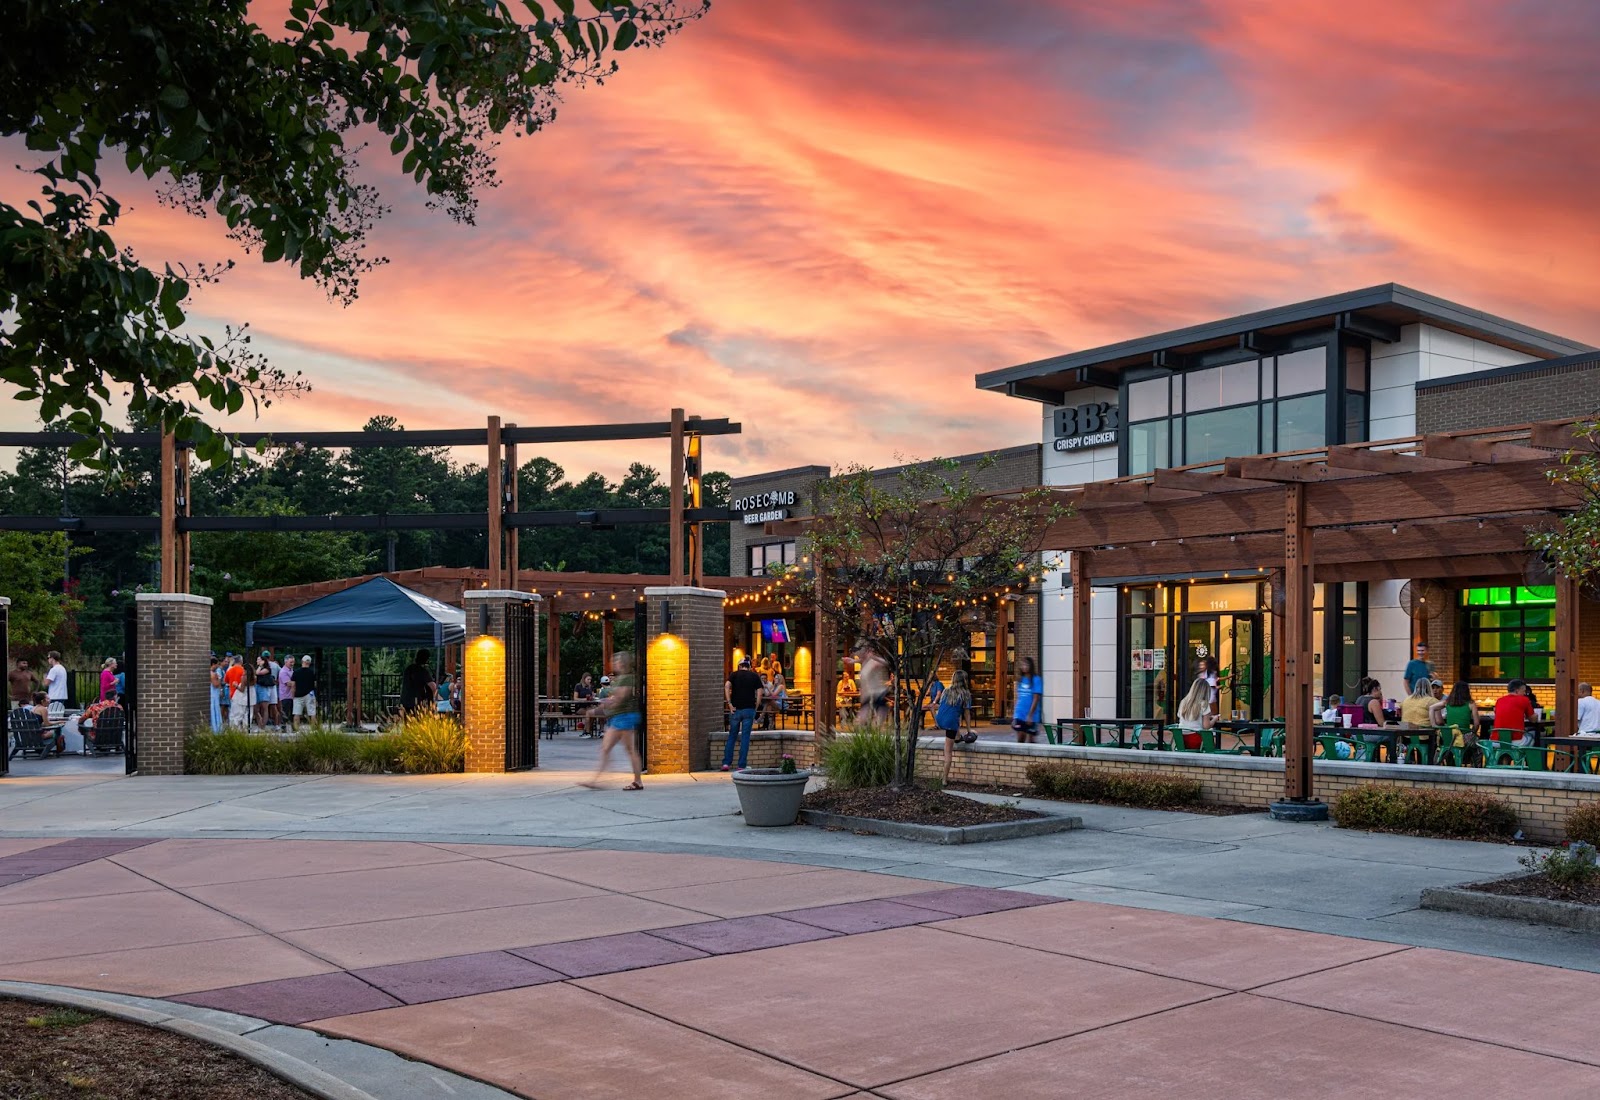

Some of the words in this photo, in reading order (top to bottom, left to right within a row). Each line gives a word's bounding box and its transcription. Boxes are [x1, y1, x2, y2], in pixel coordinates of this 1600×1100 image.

[1054, 402, 1119, 437] BB's
[1057, 437, 1082, 450] CRISPY
[1083, 431, 1115, 446] CHICKEN
[744, 513, 759, 524] BEER
[759, 510, 782, 521] GARDEN
[1210, 600, 1228, 610] 1141
